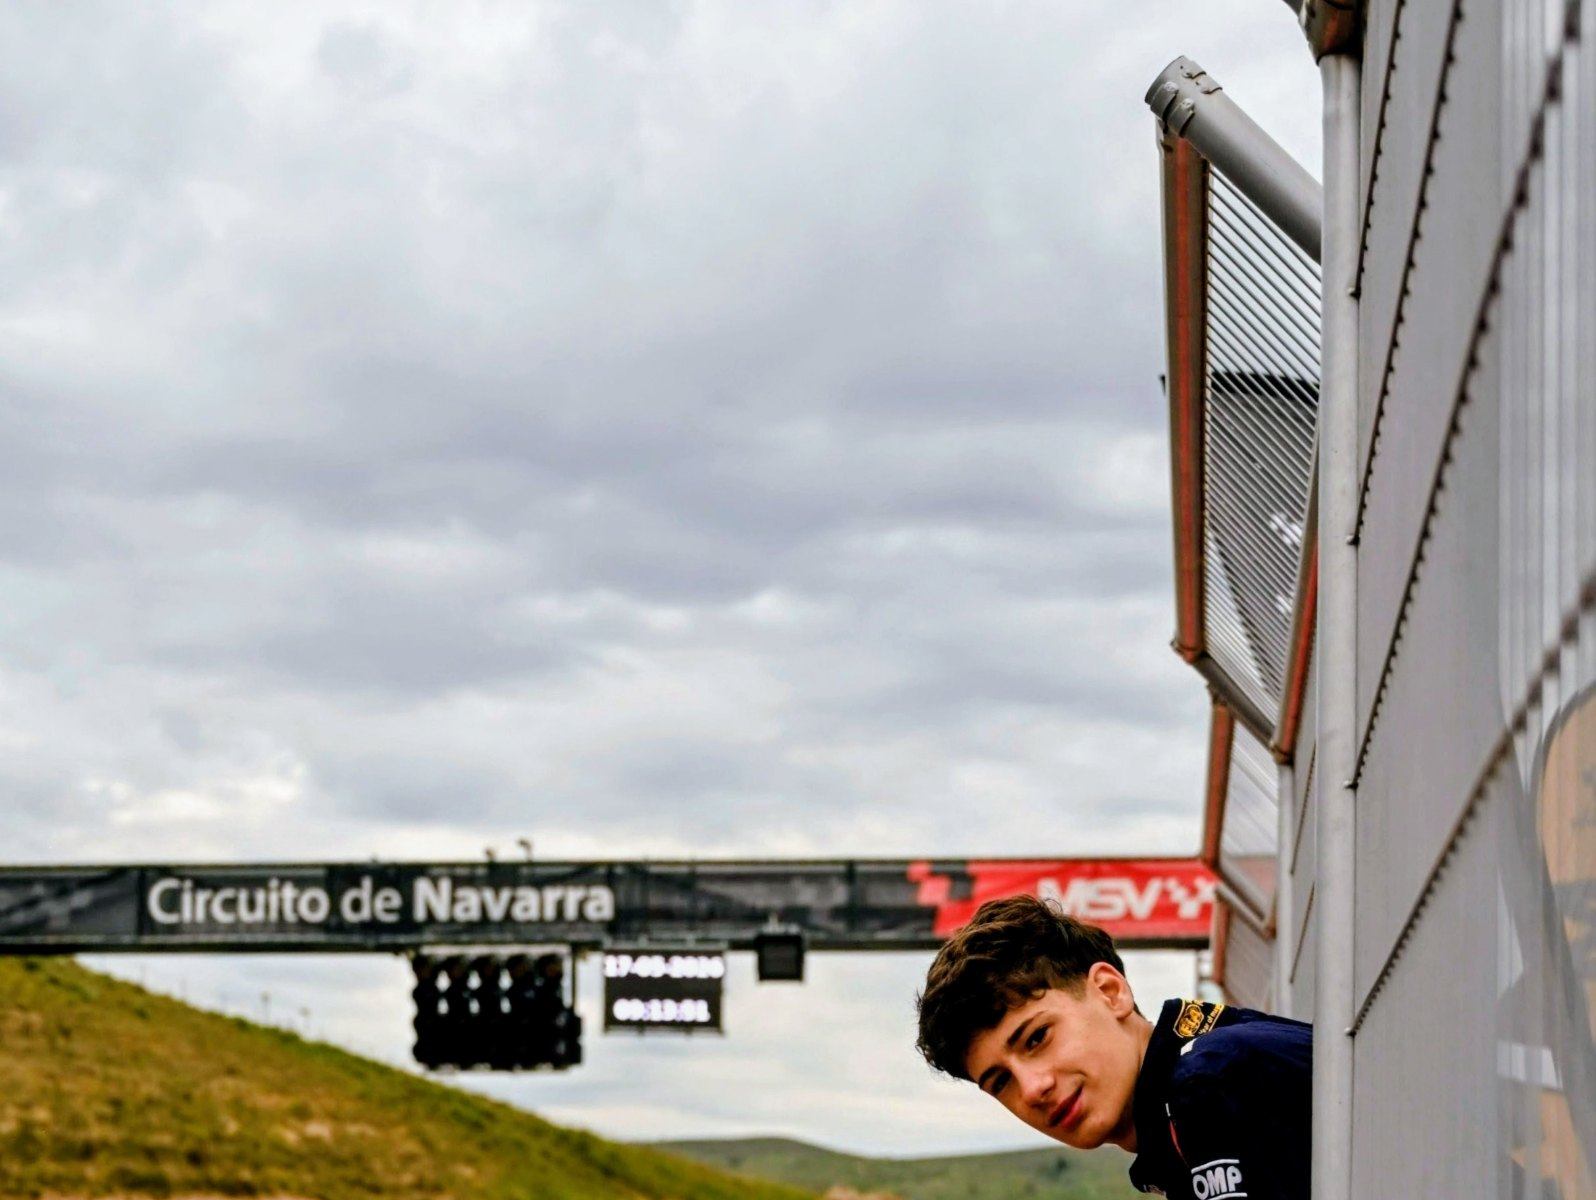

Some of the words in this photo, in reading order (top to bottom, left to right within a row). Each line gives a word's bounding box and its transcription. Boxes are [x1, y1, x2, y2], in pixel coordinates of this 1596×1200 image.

[148, 876, 331, 924] Circuito
[340, 875, 403, 923] de
[412, 876, 616, 923] Navarra
[1037, 877, 1163, 920] MSV
[1192, 1165, 1242, 1200] OMP
